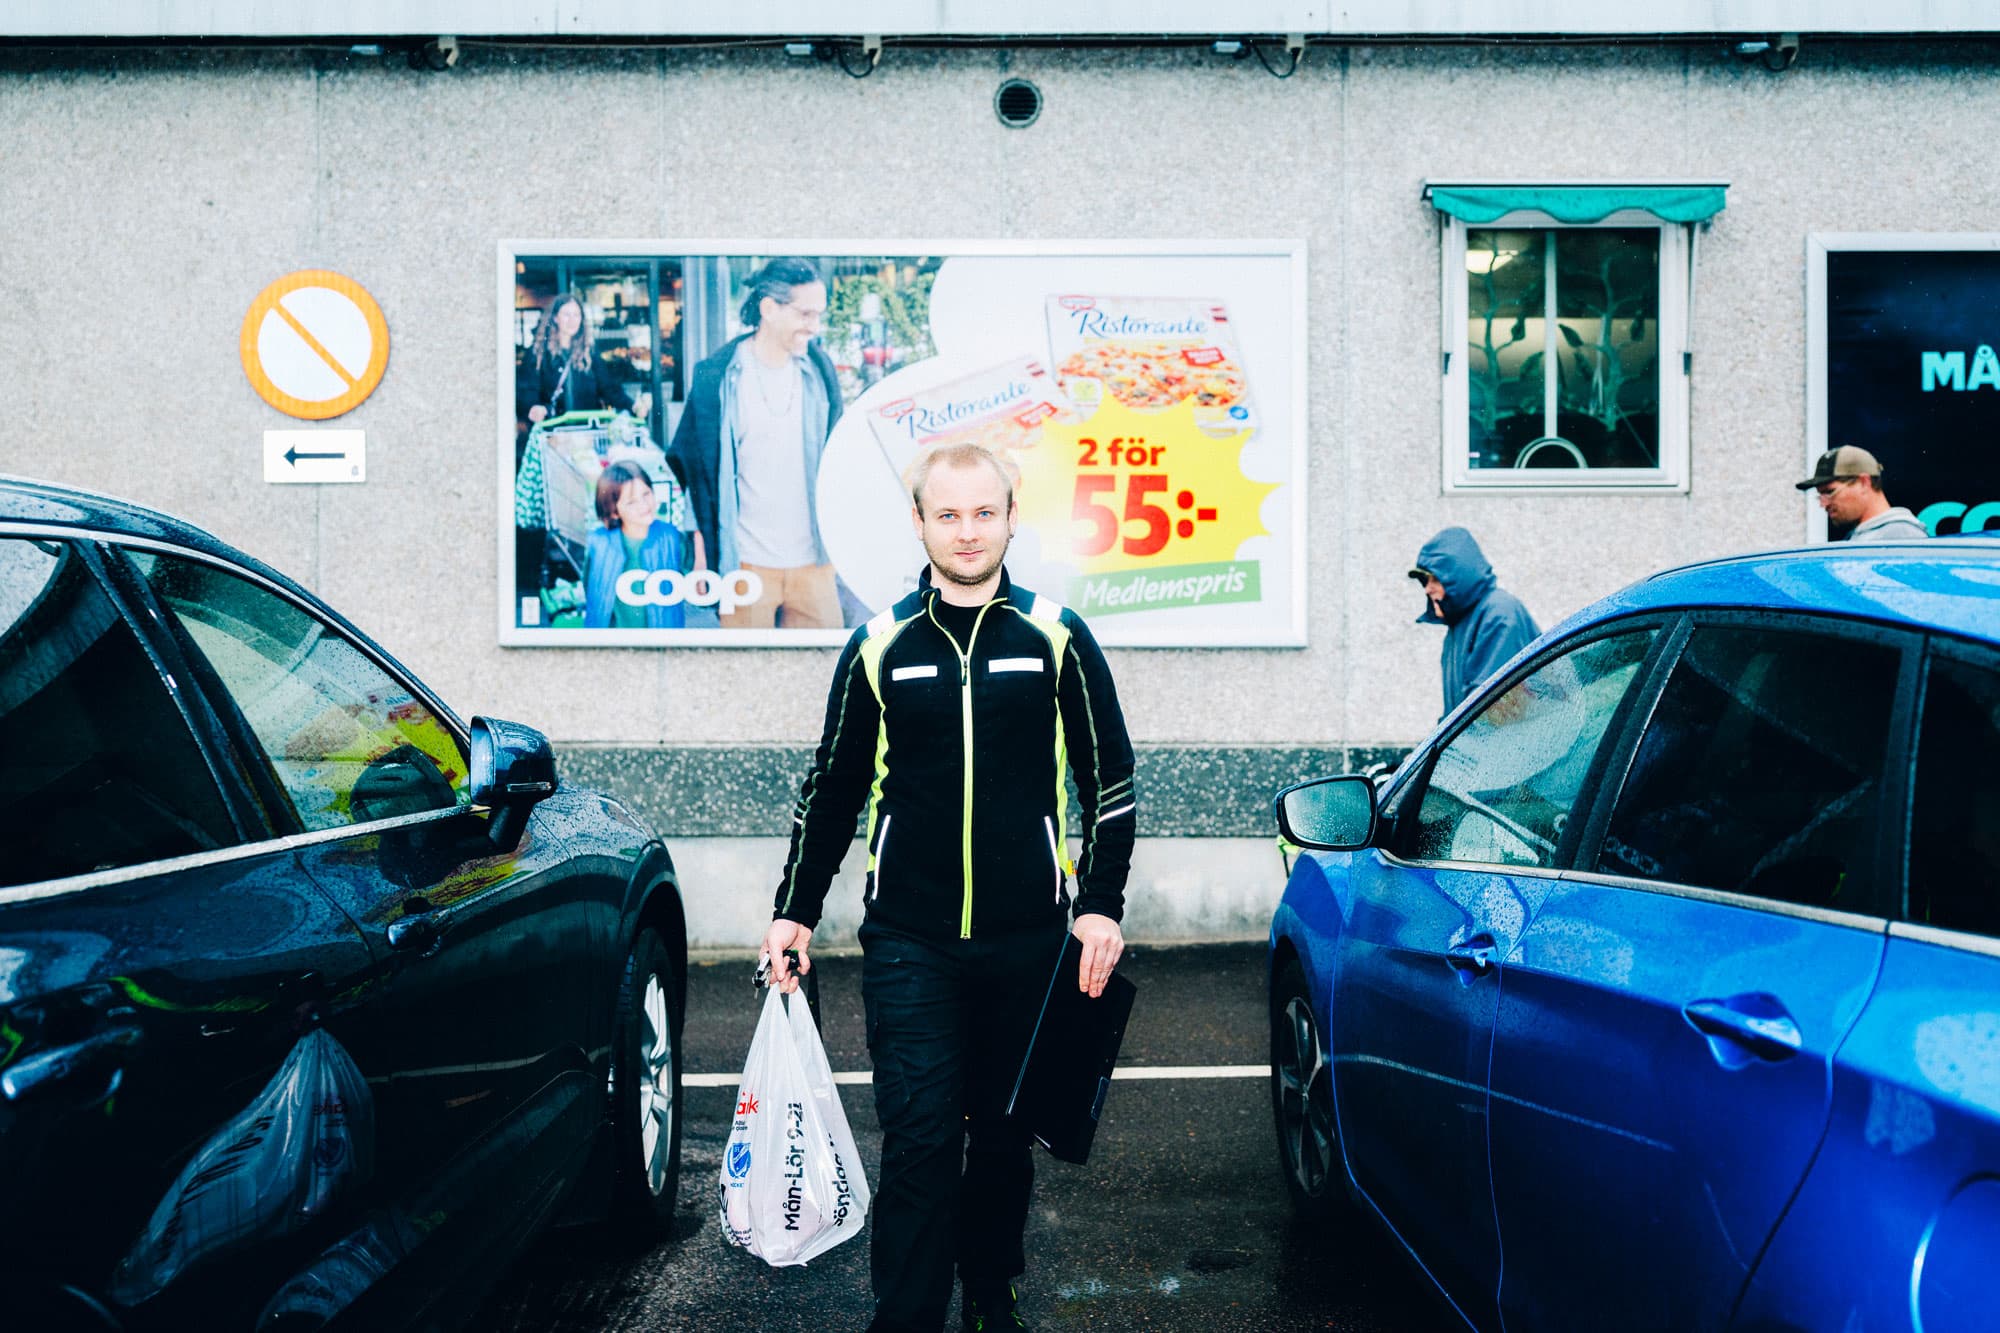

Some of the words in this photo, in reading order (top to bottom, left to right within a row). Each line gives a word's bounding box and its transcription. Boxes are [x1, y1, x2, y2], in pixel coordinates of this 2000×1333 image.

[1070, 308, 1207, 338] Ristorante
[896, 382, 1031, 439] Ristorante
[1077, 438, 1098, 466] 2
[1107, 437, 1166, 466] för
[1070, 474, 1217, 557] 55:-
[615, 568, 763, 615] coop
[1081, 565, 1248, 609] Medlemspris
[782, 1145, 805, 1231] Mån-Lör
